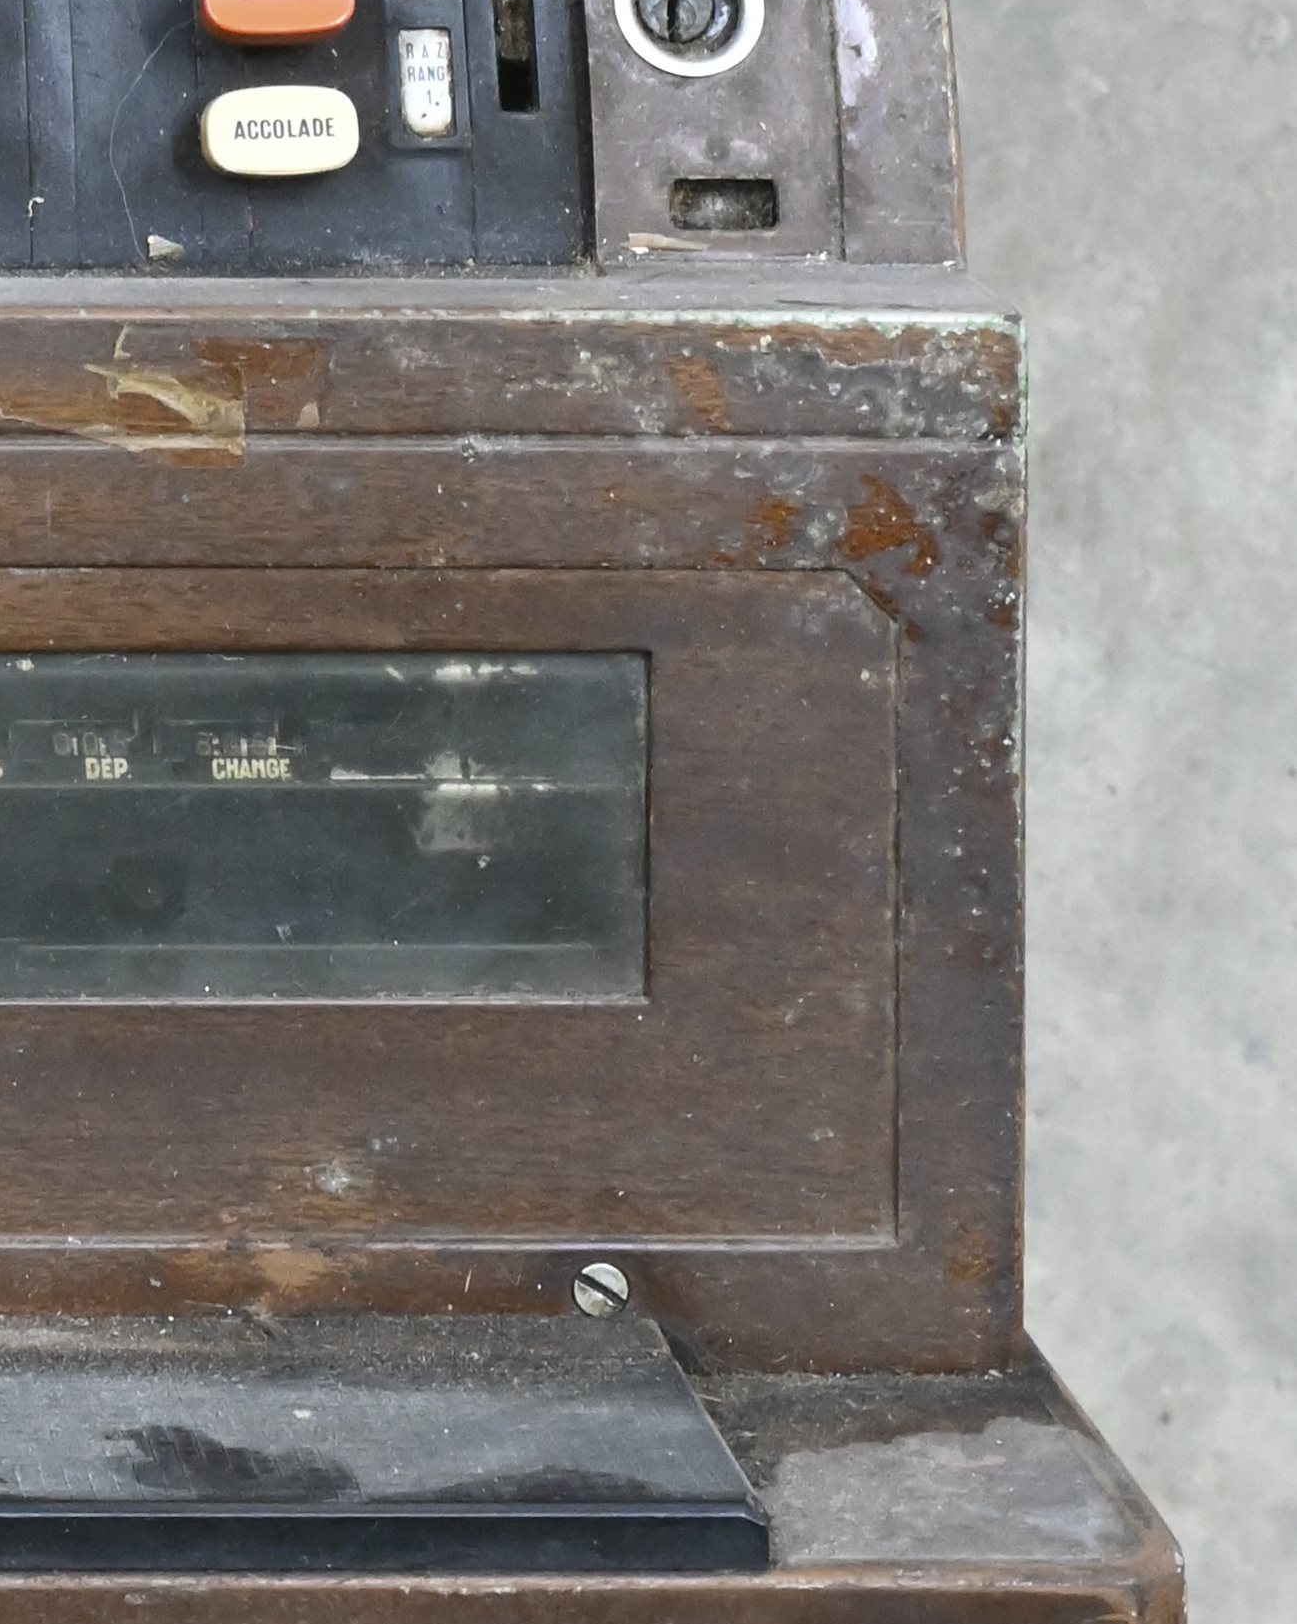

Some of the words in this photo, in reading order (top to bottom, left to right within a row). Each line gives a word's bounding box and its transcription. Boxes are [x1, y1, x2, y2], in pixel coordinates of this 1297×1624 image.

[407, 67, 444, 83] RANG
[234, 118, 335, 139] ACCOLADE
[85, 757, 132, 779] DEP.
[212, 757, 291, 779] CHANGE
